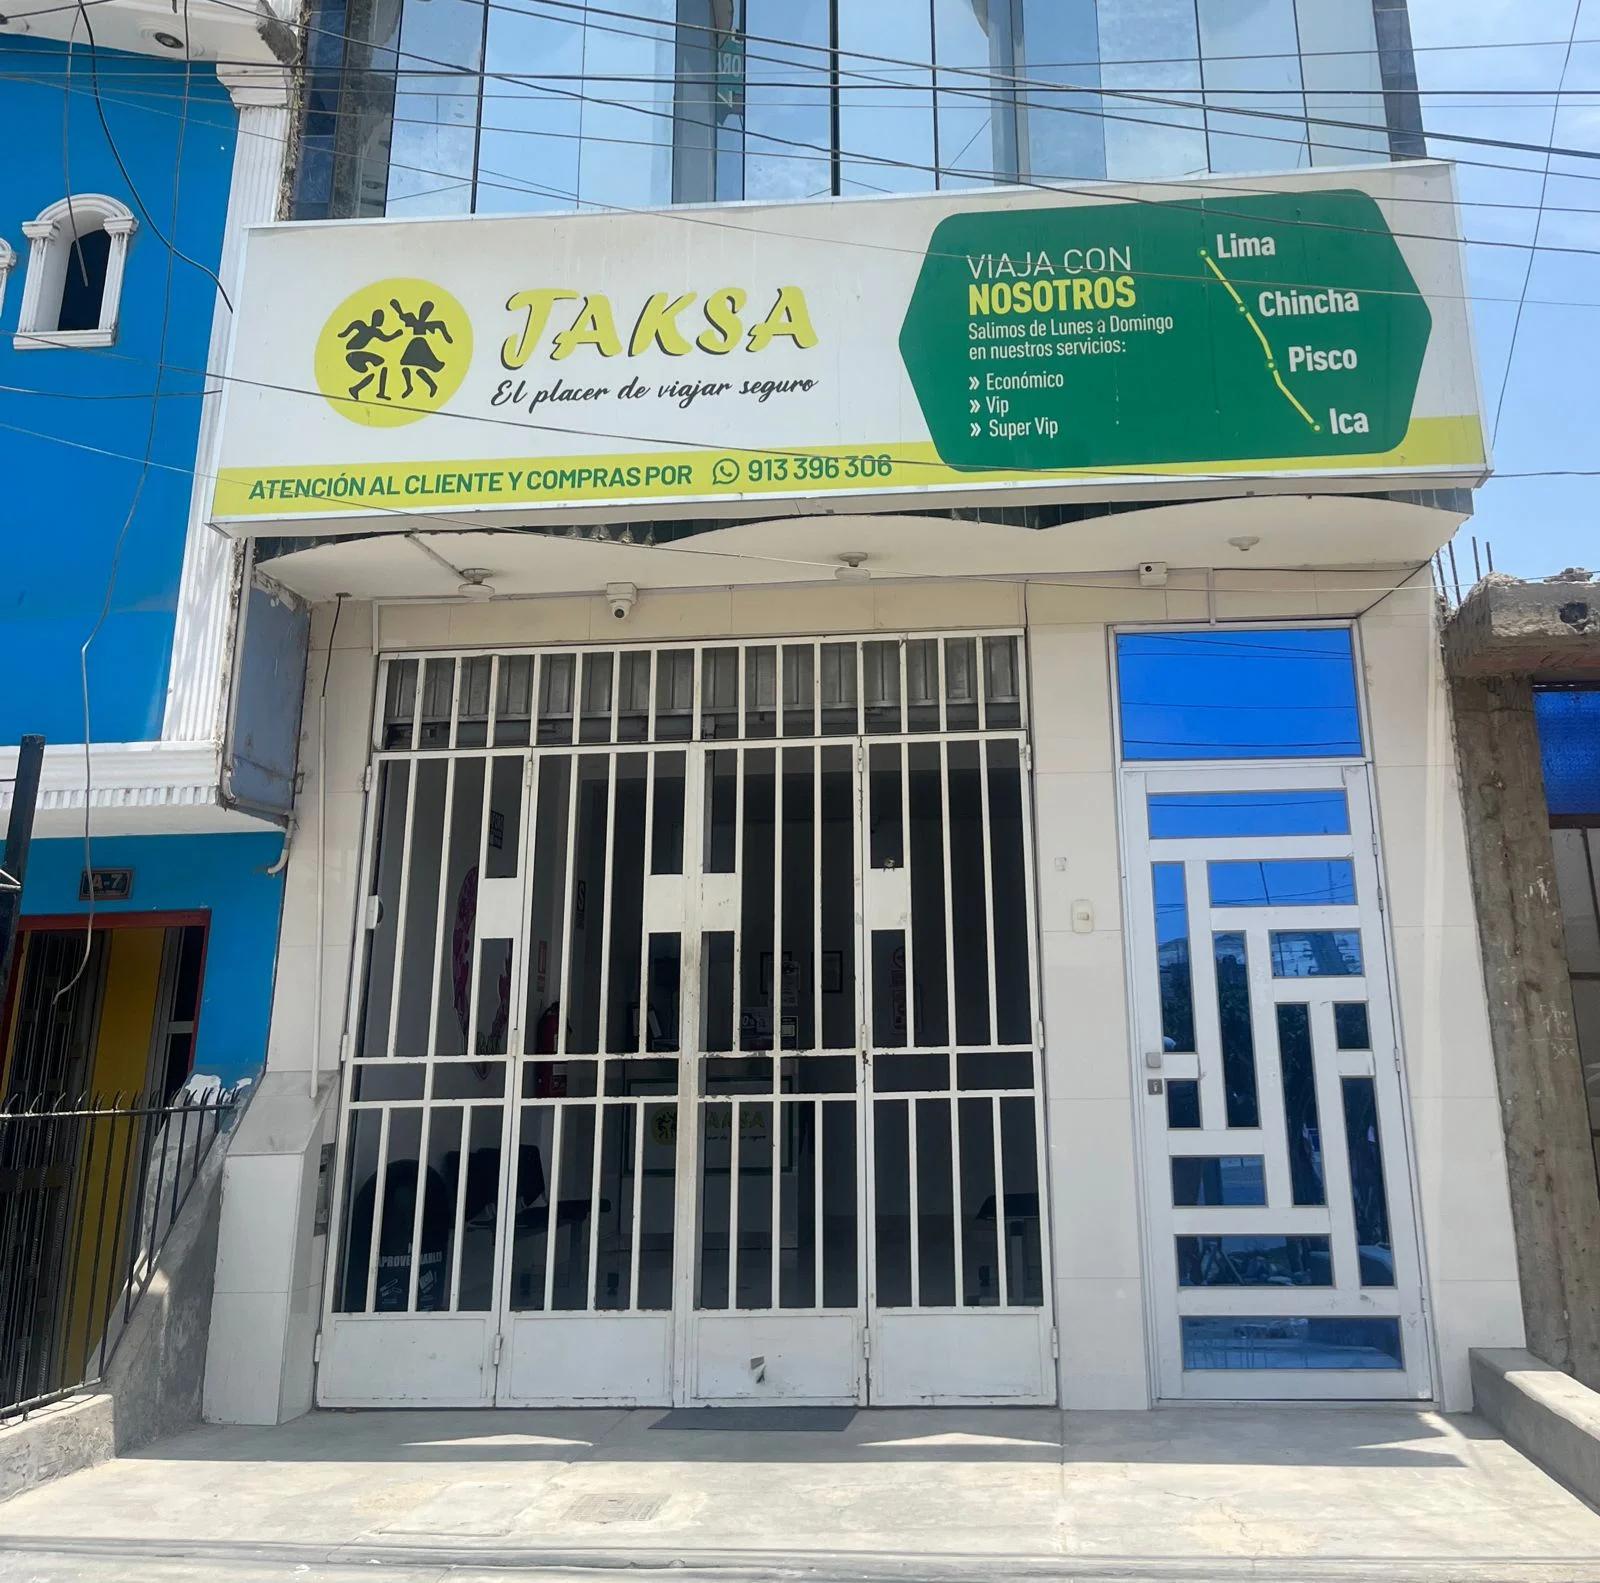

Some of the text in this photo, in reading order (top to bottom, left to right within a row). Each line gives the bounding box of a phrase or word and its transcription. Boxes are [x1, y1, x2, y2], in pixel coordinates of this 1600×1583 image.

[1217, 233, 1275, 258] Lima
[967, 247, 1130, 279] VIAJA CON
[968, 277, 1137, 317] NOSOTROS
[1259, 289, 1359, 316] Chincha
[501, 285, 819, 371] TAKSA
[969, 316, 1172, 339] Salimos de Lunes a Domingo
[970, 338, 1126, 359] en nuestros servicios:
[1289, 346, 1357, 372] Pisco
[491, 376, 818, 413] El placer de viajar seguro
[987, 374, 1063, 390] Económico
[986, 396, 1008, 417] Vip
[990, 418, 1058, 440] Super Vip
[1330, 408, 1369, 434] Ica
[249, 466, 692, 499] ATENCIÓN AL CLIENTE Y COMPRAS POR
